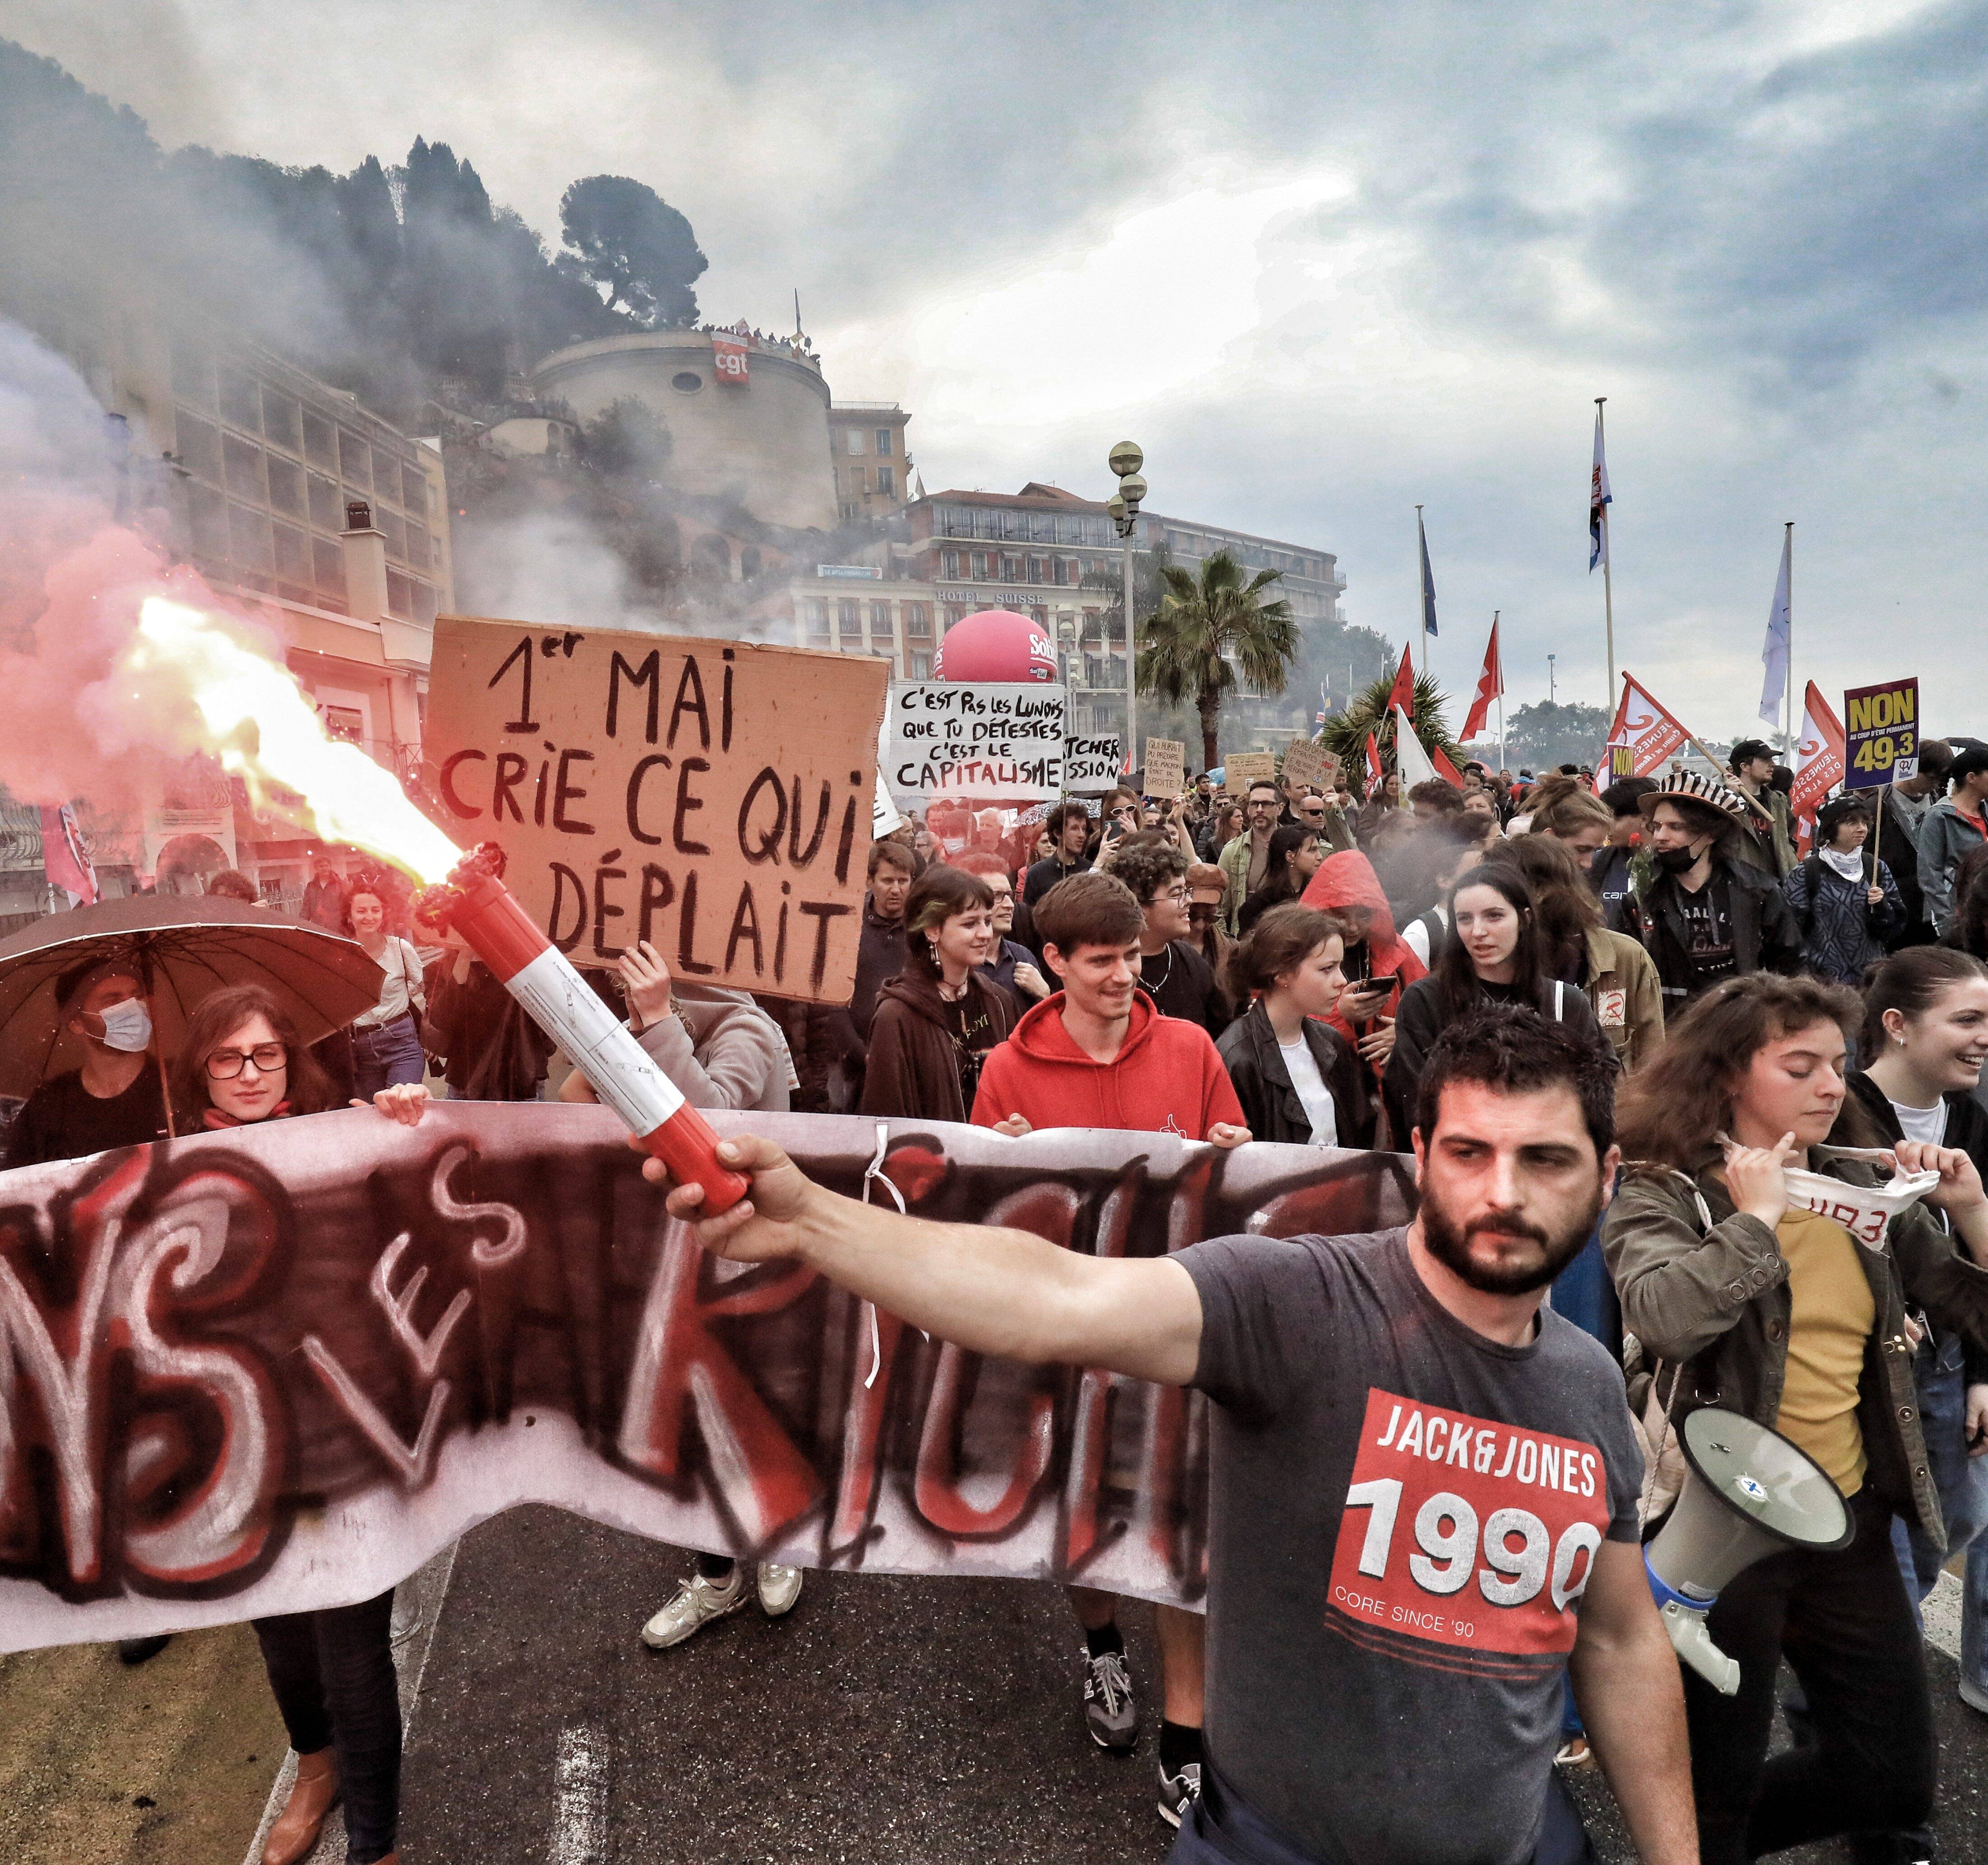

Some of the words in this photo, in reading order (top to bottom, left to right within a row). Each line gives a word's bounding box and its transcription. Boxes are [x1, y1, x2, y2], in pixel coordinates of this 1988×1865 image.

[715, 353, 748, 374] cgt
[937, 591, 981, 602] HOTEL
[995, 593, 1045, 604] SUISSE
[488, 633, 585, 733] 1er
[902, 687, 958, 710] C'EST
[1849, 688, 1914, 733] NON
[903, 722, 938, 739] QUE
[944, 719, 962, 739] TU
[973, 719, 1062, 741] DÉTESTES
[1871, 728, 1886, 738] D'ÉTAT
[1886, 722, 1915, 734] PERMANENT
[930, 742, 980, 760] C'EST
[989, 743, 1012, 757] LE
[1063, 736, 1119, 762] TCHER
[1149, 741, 1160, 750] QUI
[1292, 738, 1300, 747] LA
[1853, 732, 1914, 772] 49.3
[1613, 748, 1633, 776] NON
[1146, 776, 1175, 788] DROITE
[1312, 775, 1323, 783] OUI
[627, 754, 711, 855] CE
[1377, 1405, 1596, 1497] JACK&JONES
[1346, 1478, 1602, 1613] 1990
[1335, 1585, 1386, 1616] CORE
[1391, 1605, 1445, 1632] SINCE
[1451, 1619, 1474, 1638] '90
